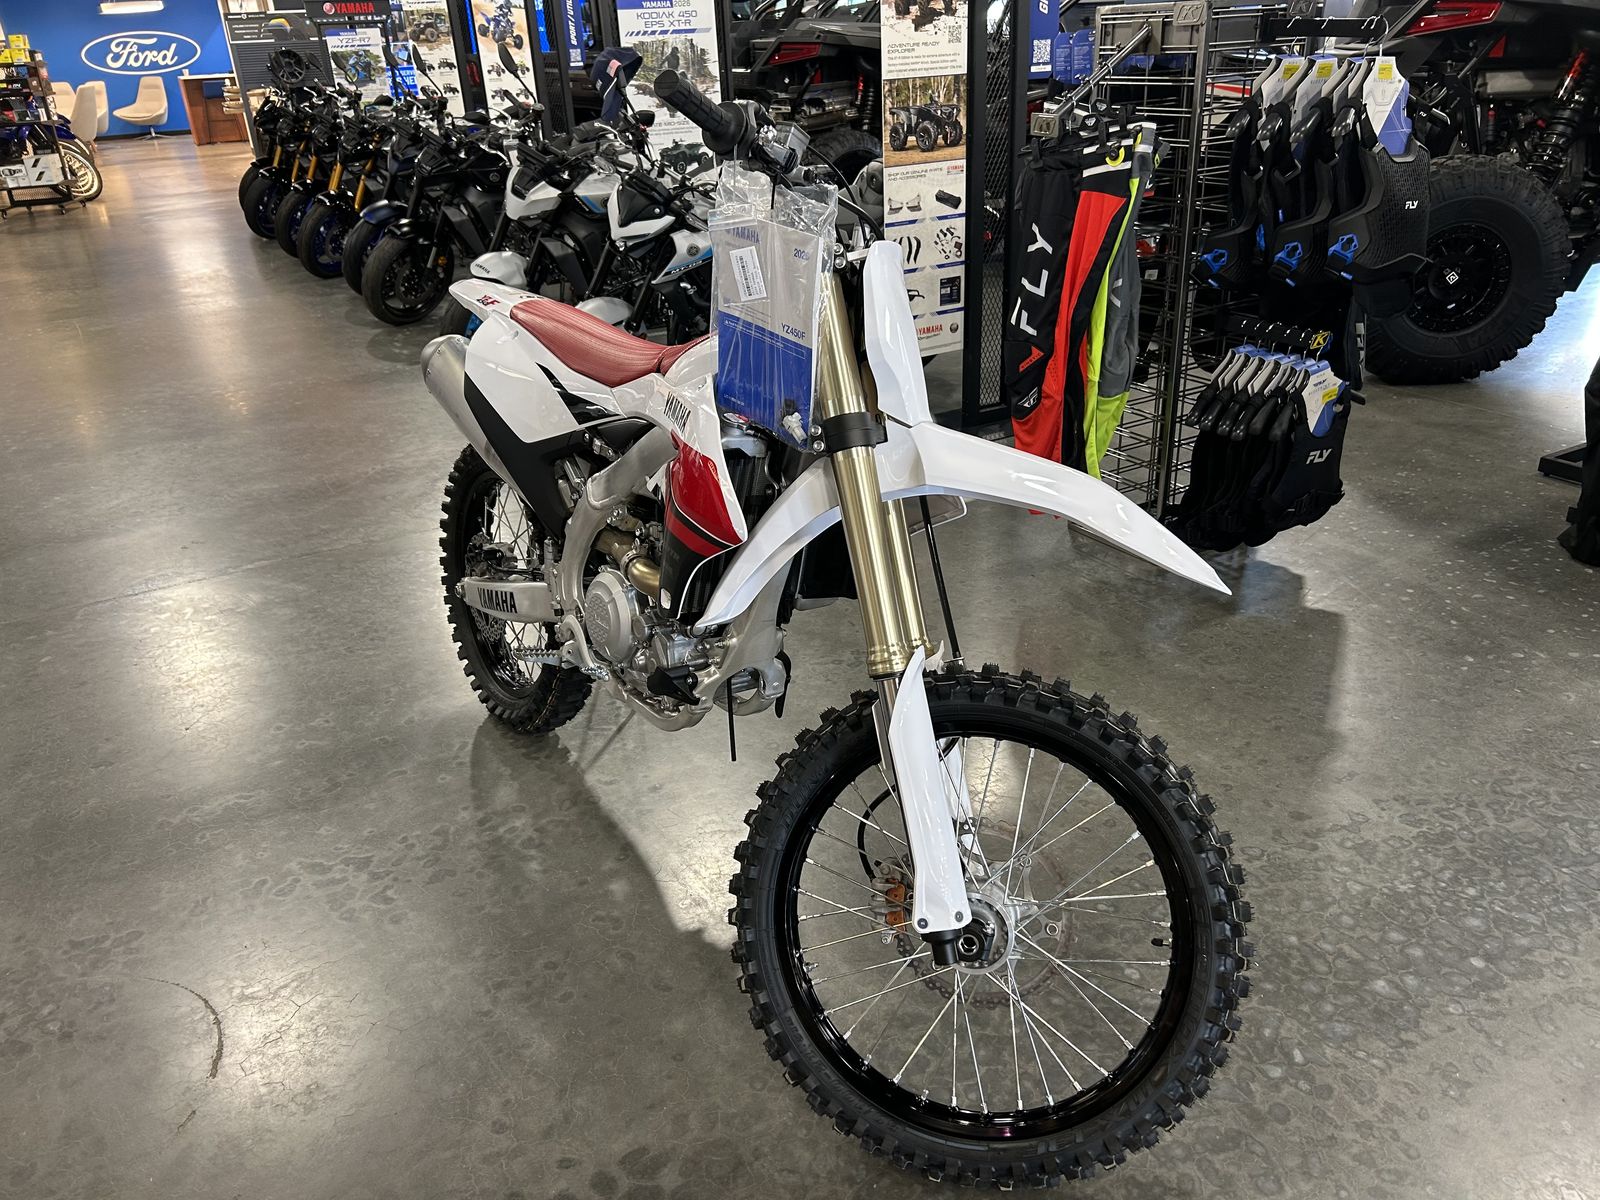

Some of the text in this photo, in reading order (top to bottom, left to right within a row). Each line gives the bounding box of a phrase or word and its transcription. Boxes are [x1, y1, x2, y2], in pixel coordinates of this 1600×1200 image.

[335, 2, 375, 14] YAMAHA
[641, 1, 672, 9] YAMAHA
[636, 9, 698, 20] KODIAK 450
[644, 19, 692, 29] EPS XT-R
[337, 36, 371, 44] YZF-R7
[568, 20, 578, 46] SPORT
[106, 37, 178, 69] Ford
[1405, 200, 1420, 210] FLY
[732, 226, 761, 244] YAMAHA
[1009, 222, 1053, 337] FLY
[781, 322, 806, 341] YZ450F
[918, 323, 943, 336] YAMAHA
[663, 390, 692, 433] YAMAHA
[1306, 448, 1333, 465] FLY
[477, 586, 518, 614] YAMAHA
